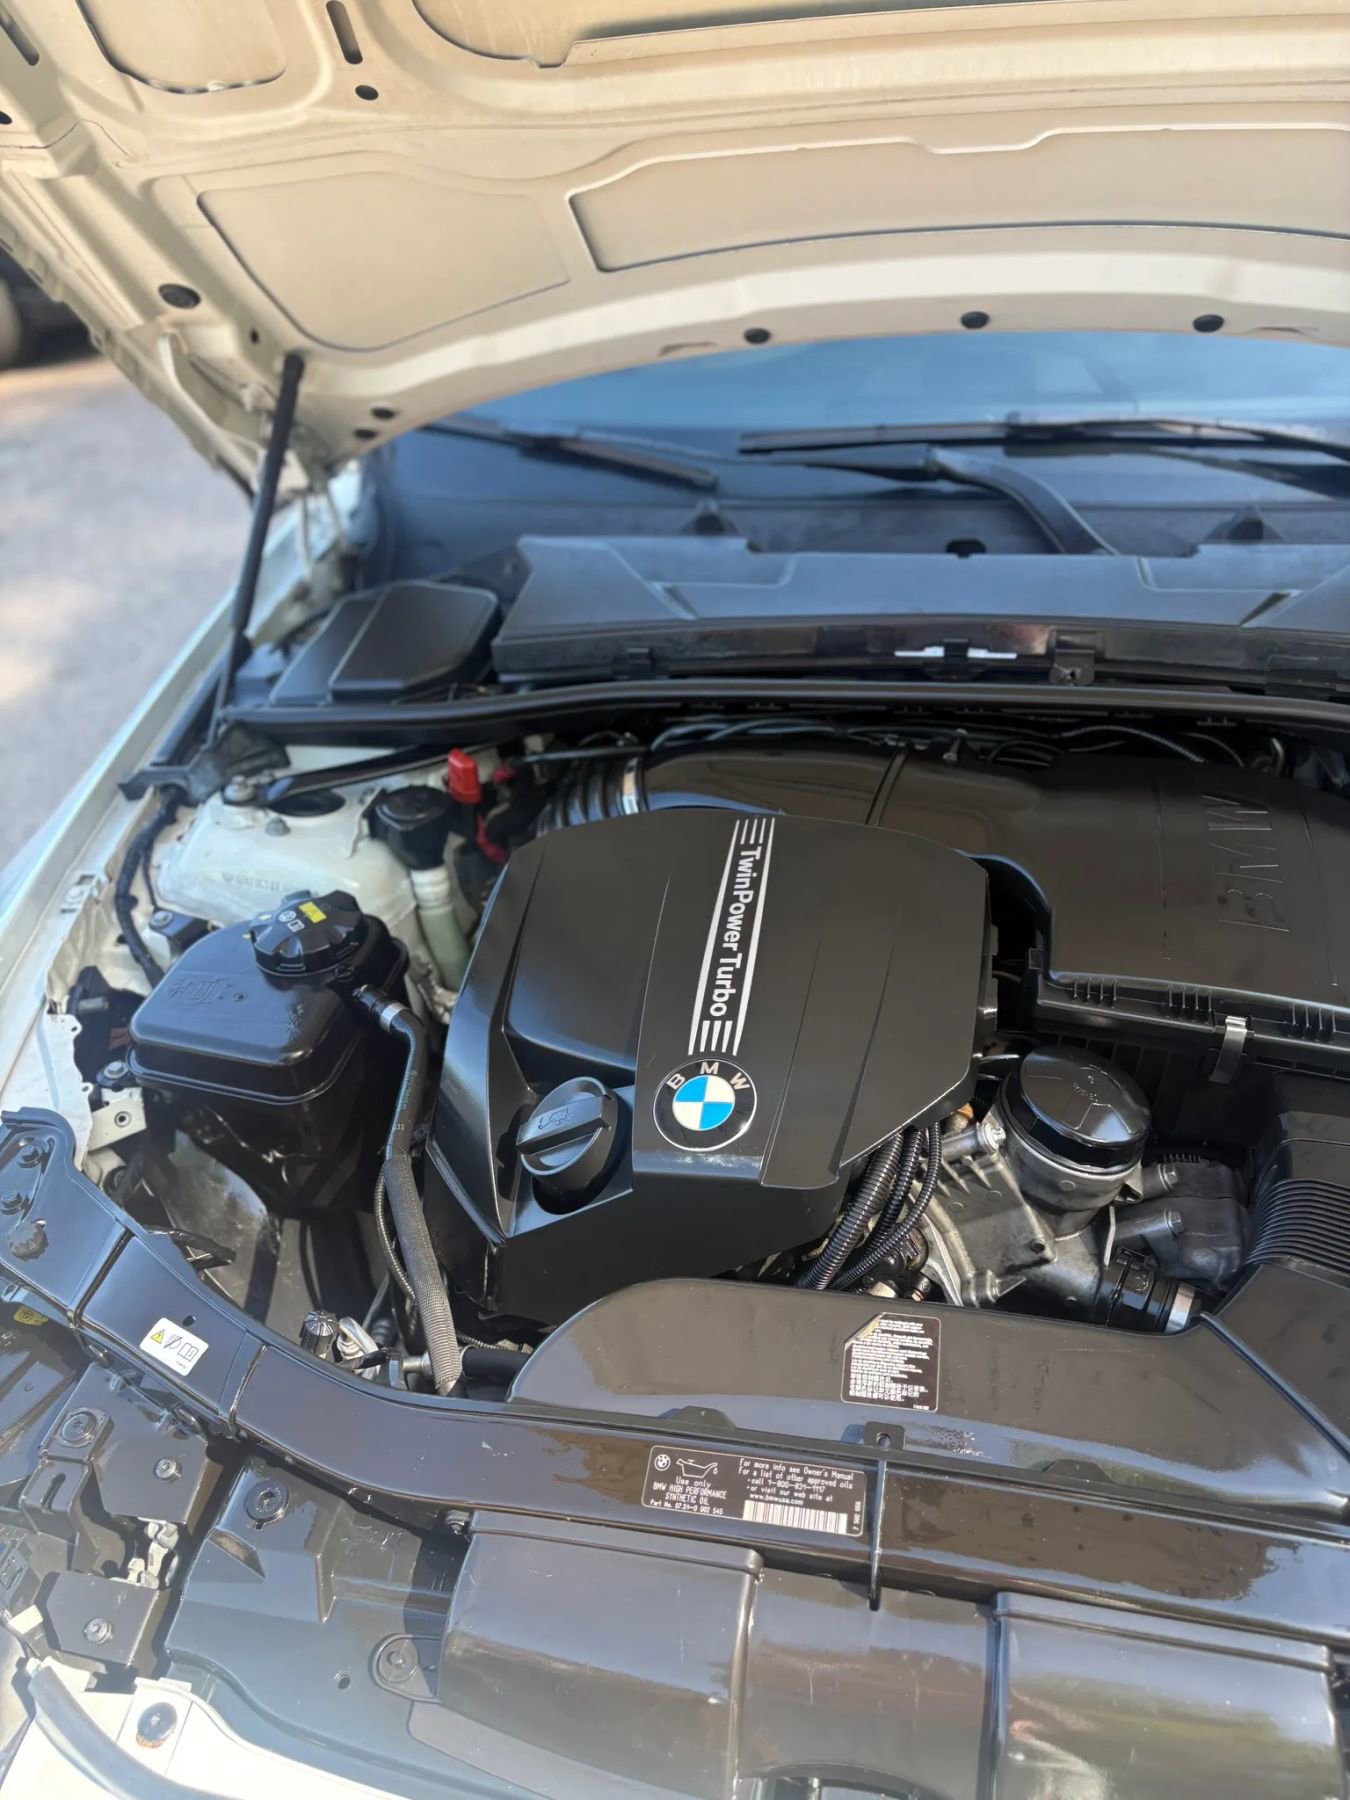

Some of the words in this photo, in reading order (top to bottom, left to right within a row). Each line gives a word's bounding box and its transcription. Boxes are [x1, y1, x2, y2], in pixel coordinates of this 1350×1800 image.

[1202, 793, 1290, 932] BMW
[723, 845, 762, 952] TwinPower
[709, 953, 742, 1017] Turbo
[666, 1061, 751, 1090] BMW
[739, 1466, 750, 1475] For
[760, 1469, 772, 1478] list
[787, 1473, 803, 1482] other
[807, 1477, 837, 1487] approved
[840, 1480, 852, 1489] oils
[740, 1458, 751, 1466] For
[773, 1464, 785, 1472] info
[804, 1467, 828, 1477] Owner's
[831, 1471, 854, 1480] Manual
[653, 1482, 667, 1490] BMW
[669, 1484, 683, 1492] HIGH
[686, 1487, 727, 1499] PERFORMANCE
[676, 1476, 689, 1485] Use
[694, 1480, 711, 1488] only
[665, 1492, 697, 1503] SYNTHETIC
[700, 1496, 709, 1505] OIL
[749, 1493, 803, 1505] www.bmwusa.com
[761, 1486, 776, 1494] visit
[809, 1492, 822, 1501] site
